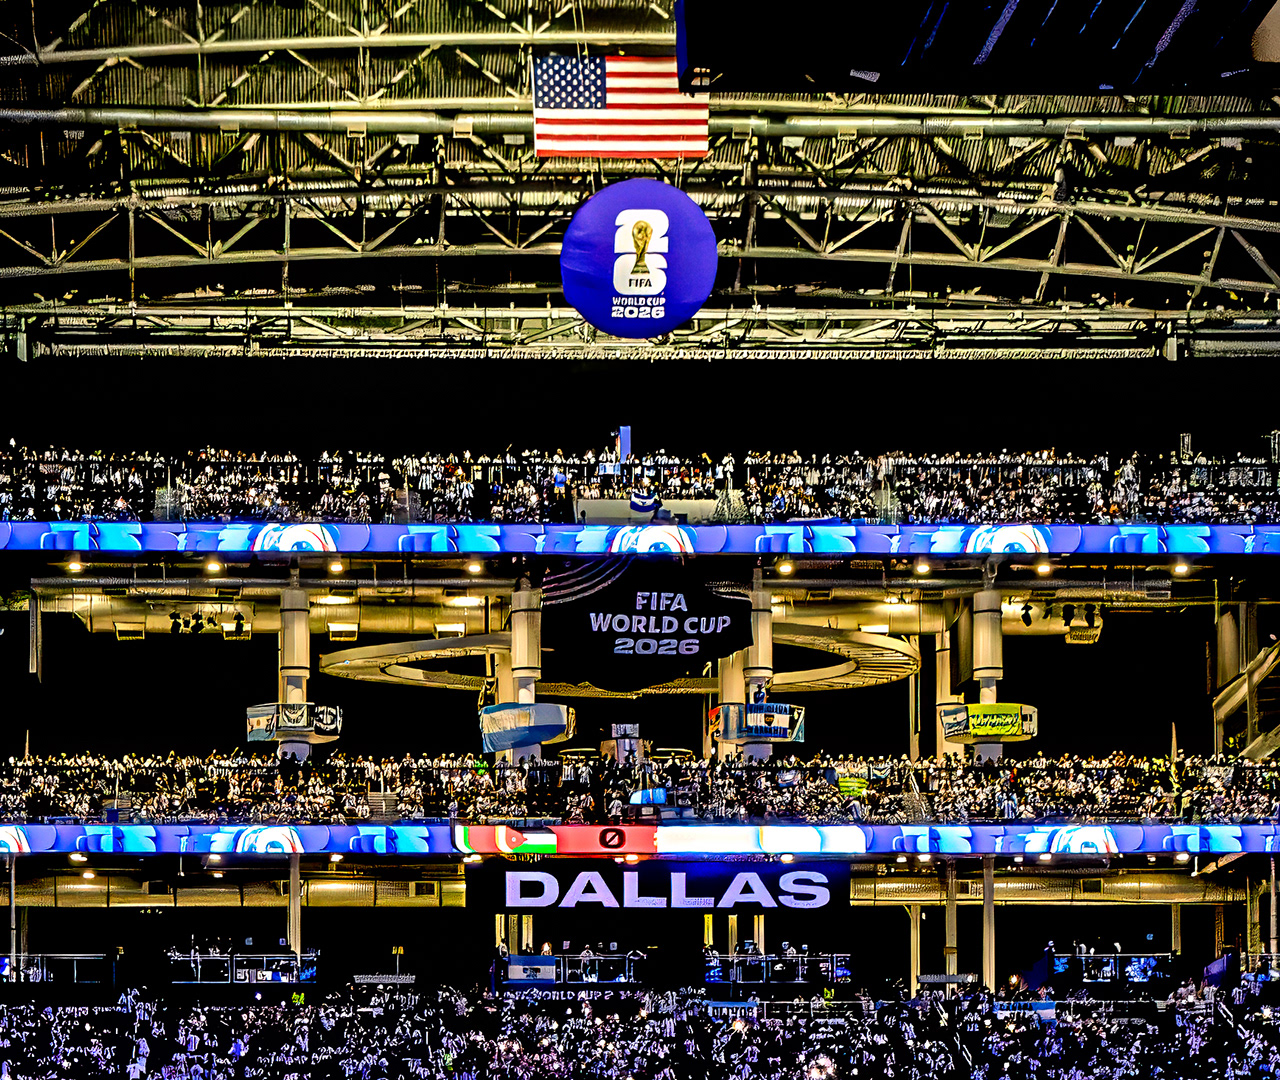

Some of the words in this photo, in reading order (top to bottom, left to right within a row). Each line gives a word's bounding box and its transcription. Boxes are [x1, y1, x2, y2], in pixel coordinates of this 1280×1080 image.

[629, 278, 653, 288] FIFA
[612, 296, 646, 306] WORLD
[647, 297, 666, 306] CUP
[611, 306, 665, 319] 2026
[636, 591, 688, 612] FIFA
[590, 612, 679, 634] WORLD
[683, 615, 731, 634] CUP
[613, 637, 700, 655] 2026
[505, 870, 831, 908] DALLAS
